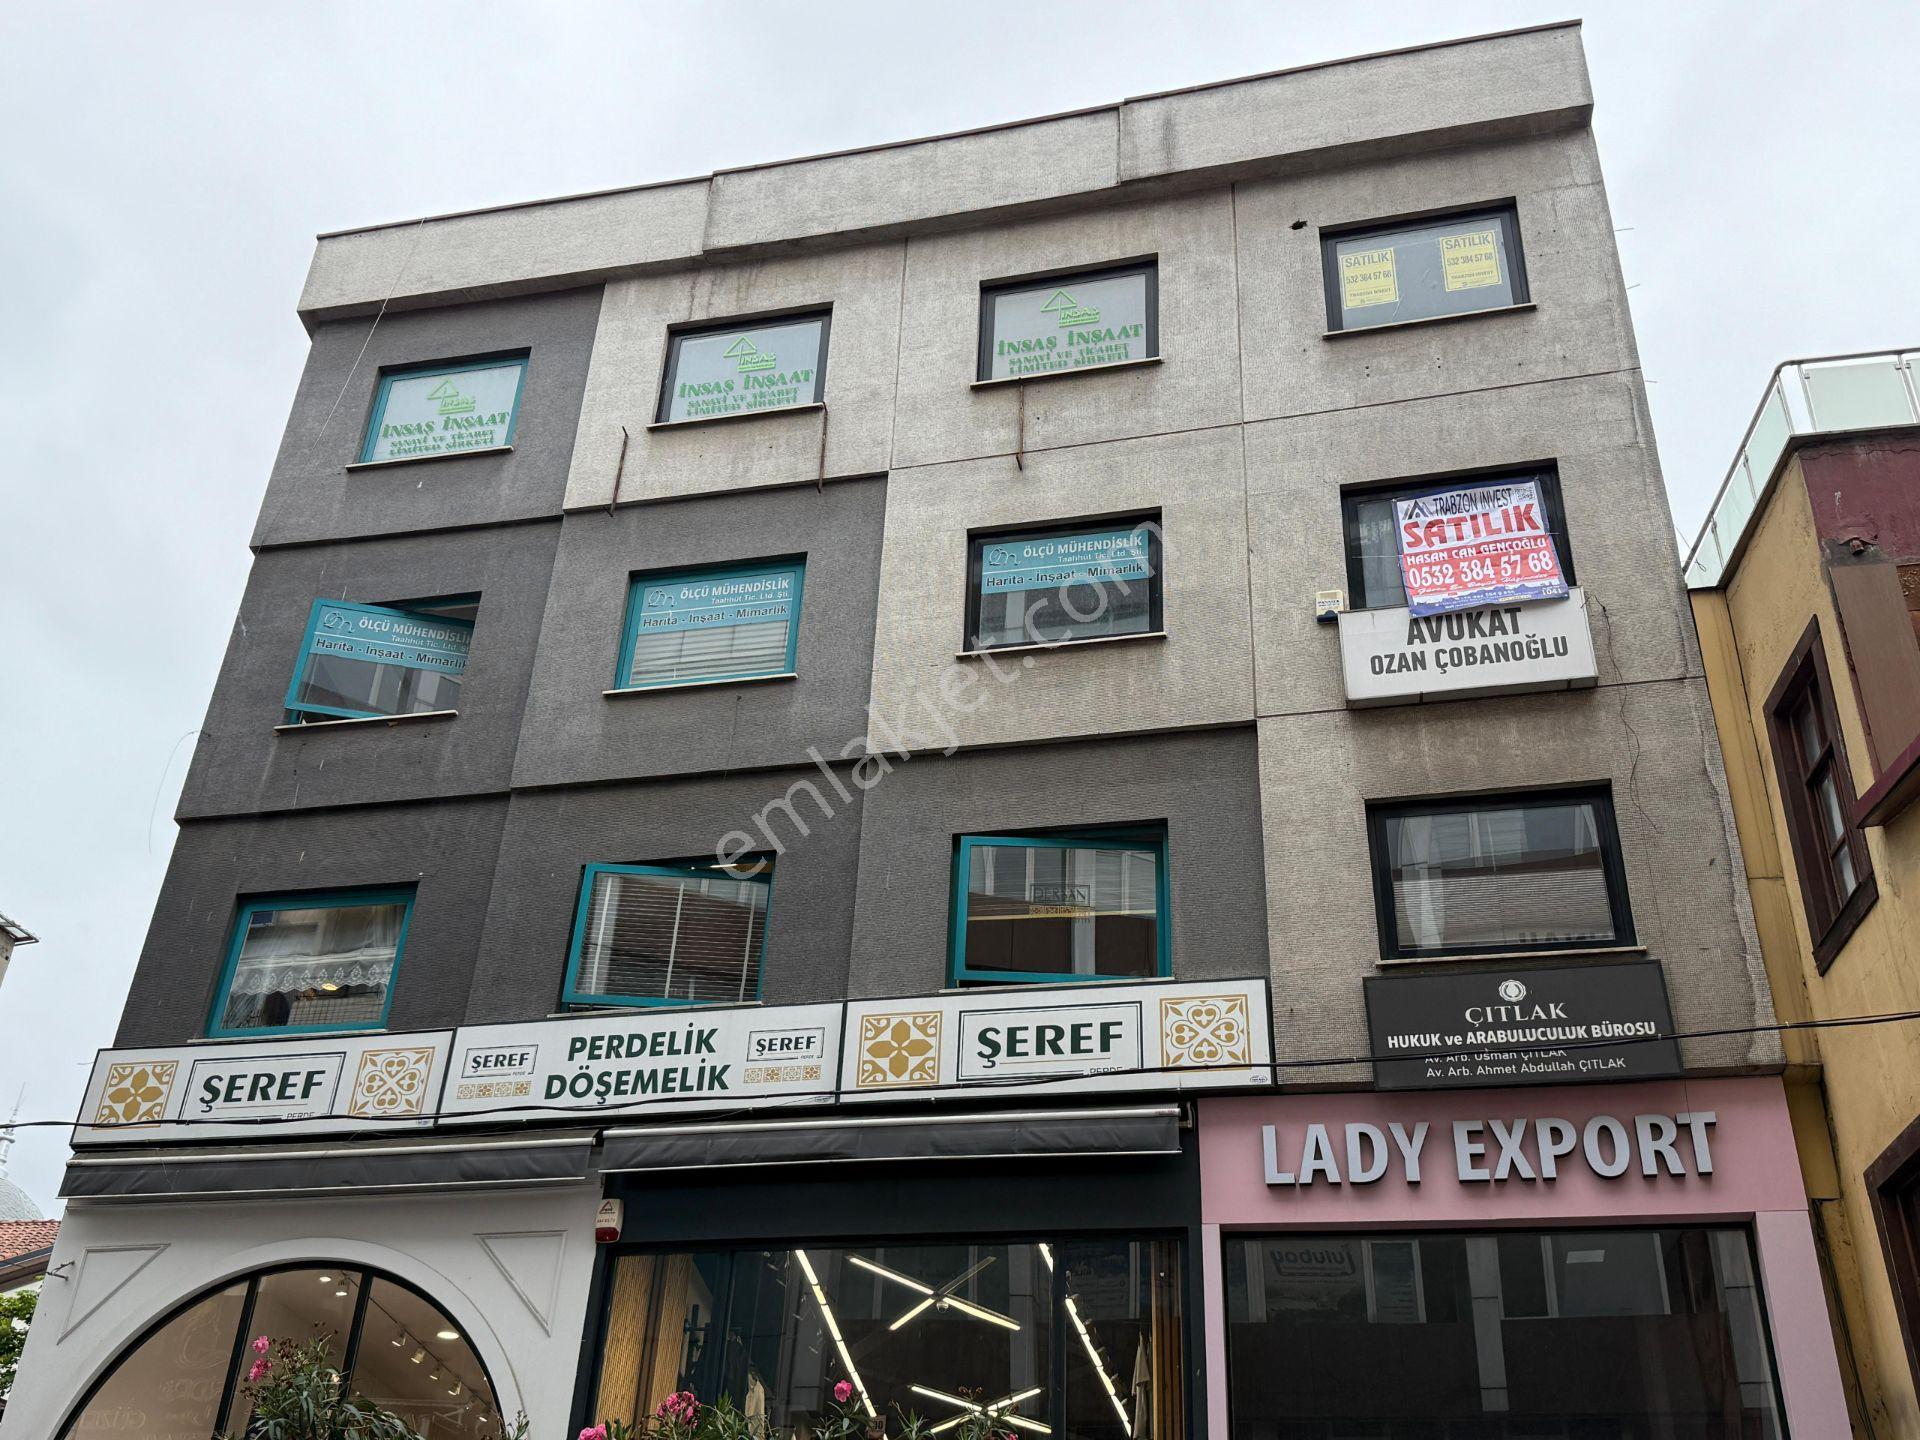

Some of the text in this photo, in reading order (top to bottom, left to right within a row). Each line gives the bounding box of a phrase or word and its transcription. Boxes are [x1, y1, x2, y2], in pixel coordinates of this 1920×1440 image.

[1445, 234, 1490, 249] SATILIK
[1345, 252, 1389, 268] SATILIK
[1432, 487, 1513, 516] TRABZON INVEST
[1403, 503, 1542, 549] SATILIK
[1023, 533, 1143, 559] ÖLÇÜ MÜHENDİSLİK
[1406, 535, 1547, 566] HASAN CAN GENÇOĞLU
[986, 575, 1024, 587] Harita
[1036, 569, 1075, 582] İnşaat
[1088, 562, 1144, 577] Mimarlık
[1408, 550, 1553, 588] 0532 384 57 68
[680, 577, 789, 600] ÖLÇÜ MÜHENDİSLİK
[359, 616, 390, 632] ÖLÇÜ
[643, 616, 678, 628] Harita
[736, 605, 787, 619] Mimarlık
[1407, 607, 1522, 646] AVUKAT
[316, 638, 354, 652] Harita
[366, 645, 404, 660] İnşaat
[1370, 634, 1569, 675] OZAN ÇOBANOĞLU
[1465, 1002, 1568, 1027] ÇITLAK
[567, 1022, 718, 1062] PERDELİK
[756, 1036, 816, 1056] ŞEREF
[977, 1020, 1123, 1068] ŞEREF
[1387, 1021, 1656, 1048] HUKUK ve ARABULUCULUK BÜROSU
[471, 1052, 530, 1072] ŞEREF
[1426, 1057, 1626, 1077] Av. Arb. Ahmet Abdullah ÇITLAK
[1474, 1052, 1517, 1060] Osman
[199, 1070, 327, 1113] ŞEREF
[544, 1057, 731, 1104] DÖŞEMELİK
[1262, 1111, 1717, 1186] LADY EXPORT
